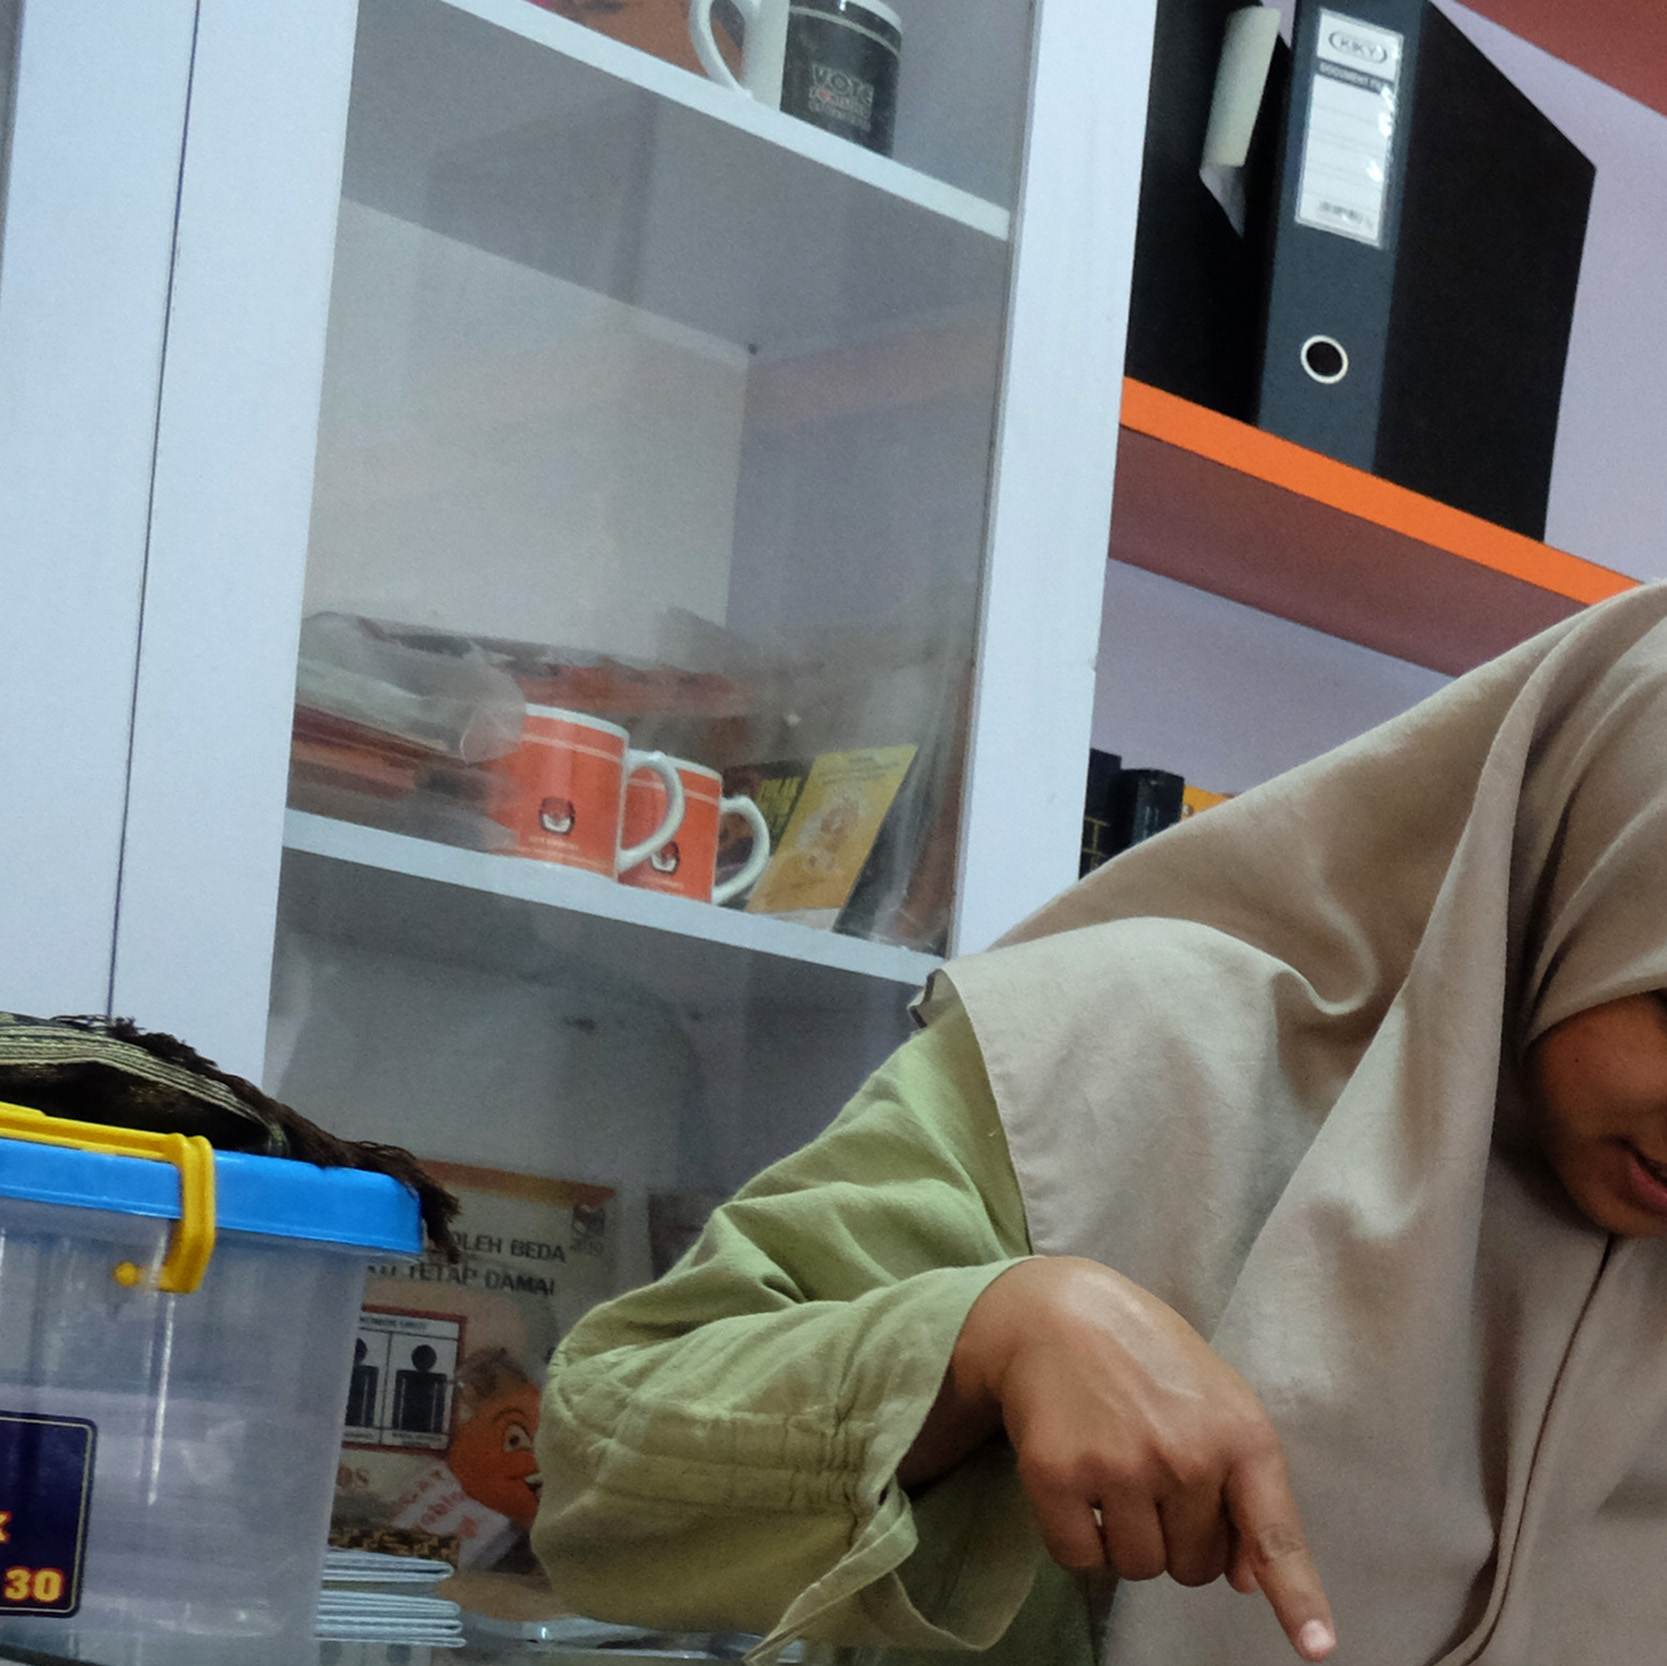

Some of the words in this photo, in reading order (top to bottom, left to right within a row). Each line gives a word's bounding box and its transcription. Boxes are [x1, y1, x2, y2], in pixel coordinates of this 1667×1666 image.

[451, 1232, 503, 1255] OLEH
[510, 1239, 567, 1263] BEDA
[485, 1270, 556, 1296] DAMAI
[3, 1566, 65, 1604] 30
